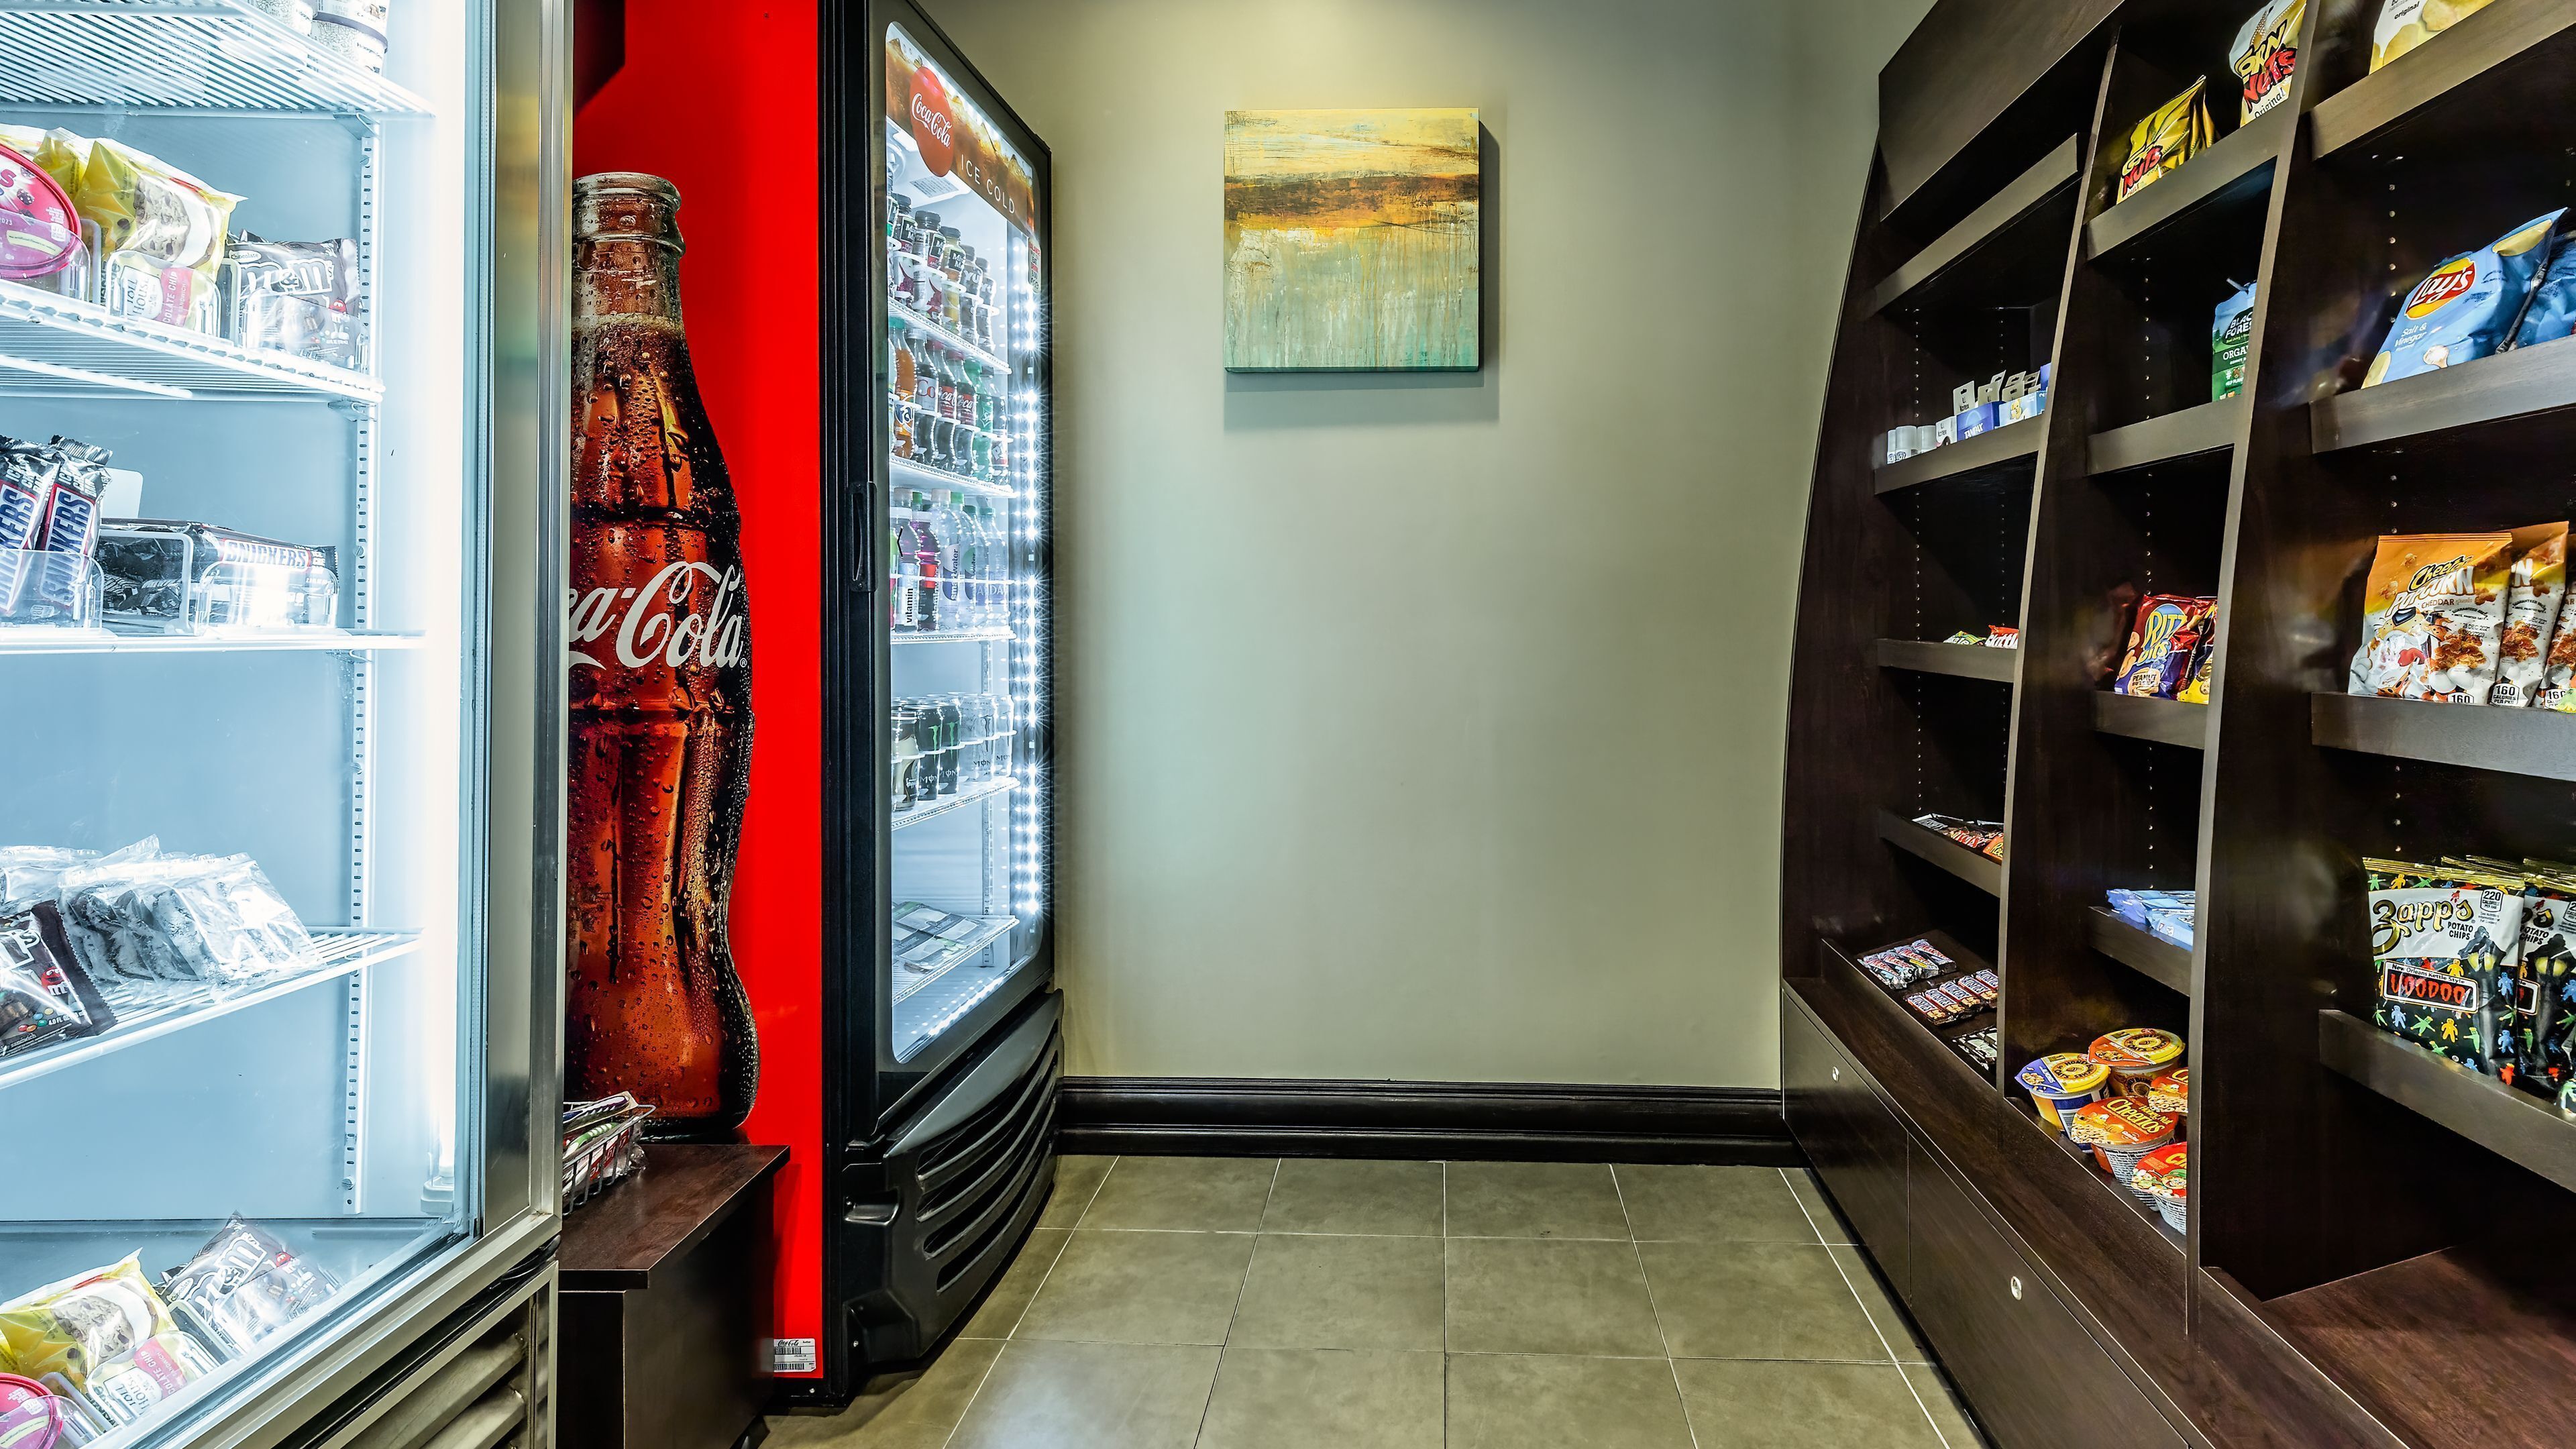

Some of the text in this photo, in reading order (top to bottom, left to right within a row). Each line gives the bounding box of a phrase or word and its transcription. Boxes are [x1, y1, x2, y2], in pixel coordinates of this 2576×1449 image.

[2394, 1, 2420, 19] original
[2255, 87, 2286, 118] Original
[912, 93, 953, 148] Coca-Cola
[961, 154, 981, 185] ICE
[987, 182, 1015, 215] COLD
[2408, 268, 2473, 305] Lay's
[2402, 322, 2427, 337] Salt &
[2395, 331, 2427, 347] Vinegar
[1964, 423, 1984, 439] TAMPAX
[42, 490, 92, 602] SNICKERS
[225, 541, 307, 568] SNICKERS
[2421, 598, 2455, 608] CHEDDAR
[2141, 610, 2188, 648] RITZ
[2133, 674, 2157, 682] PEANUT
[2496, 685, 2516, 696] 160
[2483, 891, 2500, 901] 220
[2448, 921, 2473, 933] POTATO
[2449, 930, 2471, 940] CHIPS
[2520, 934, 2544, 945] CHIPS
[2392, 963, 2465, 985] New Orleans Kettle Style
[2390, 973, 2465, 1005] VOODOO
[2106, 1099, 2165, 1134] Cheerios
[2156, 1116, 2174, 1126] Nut
